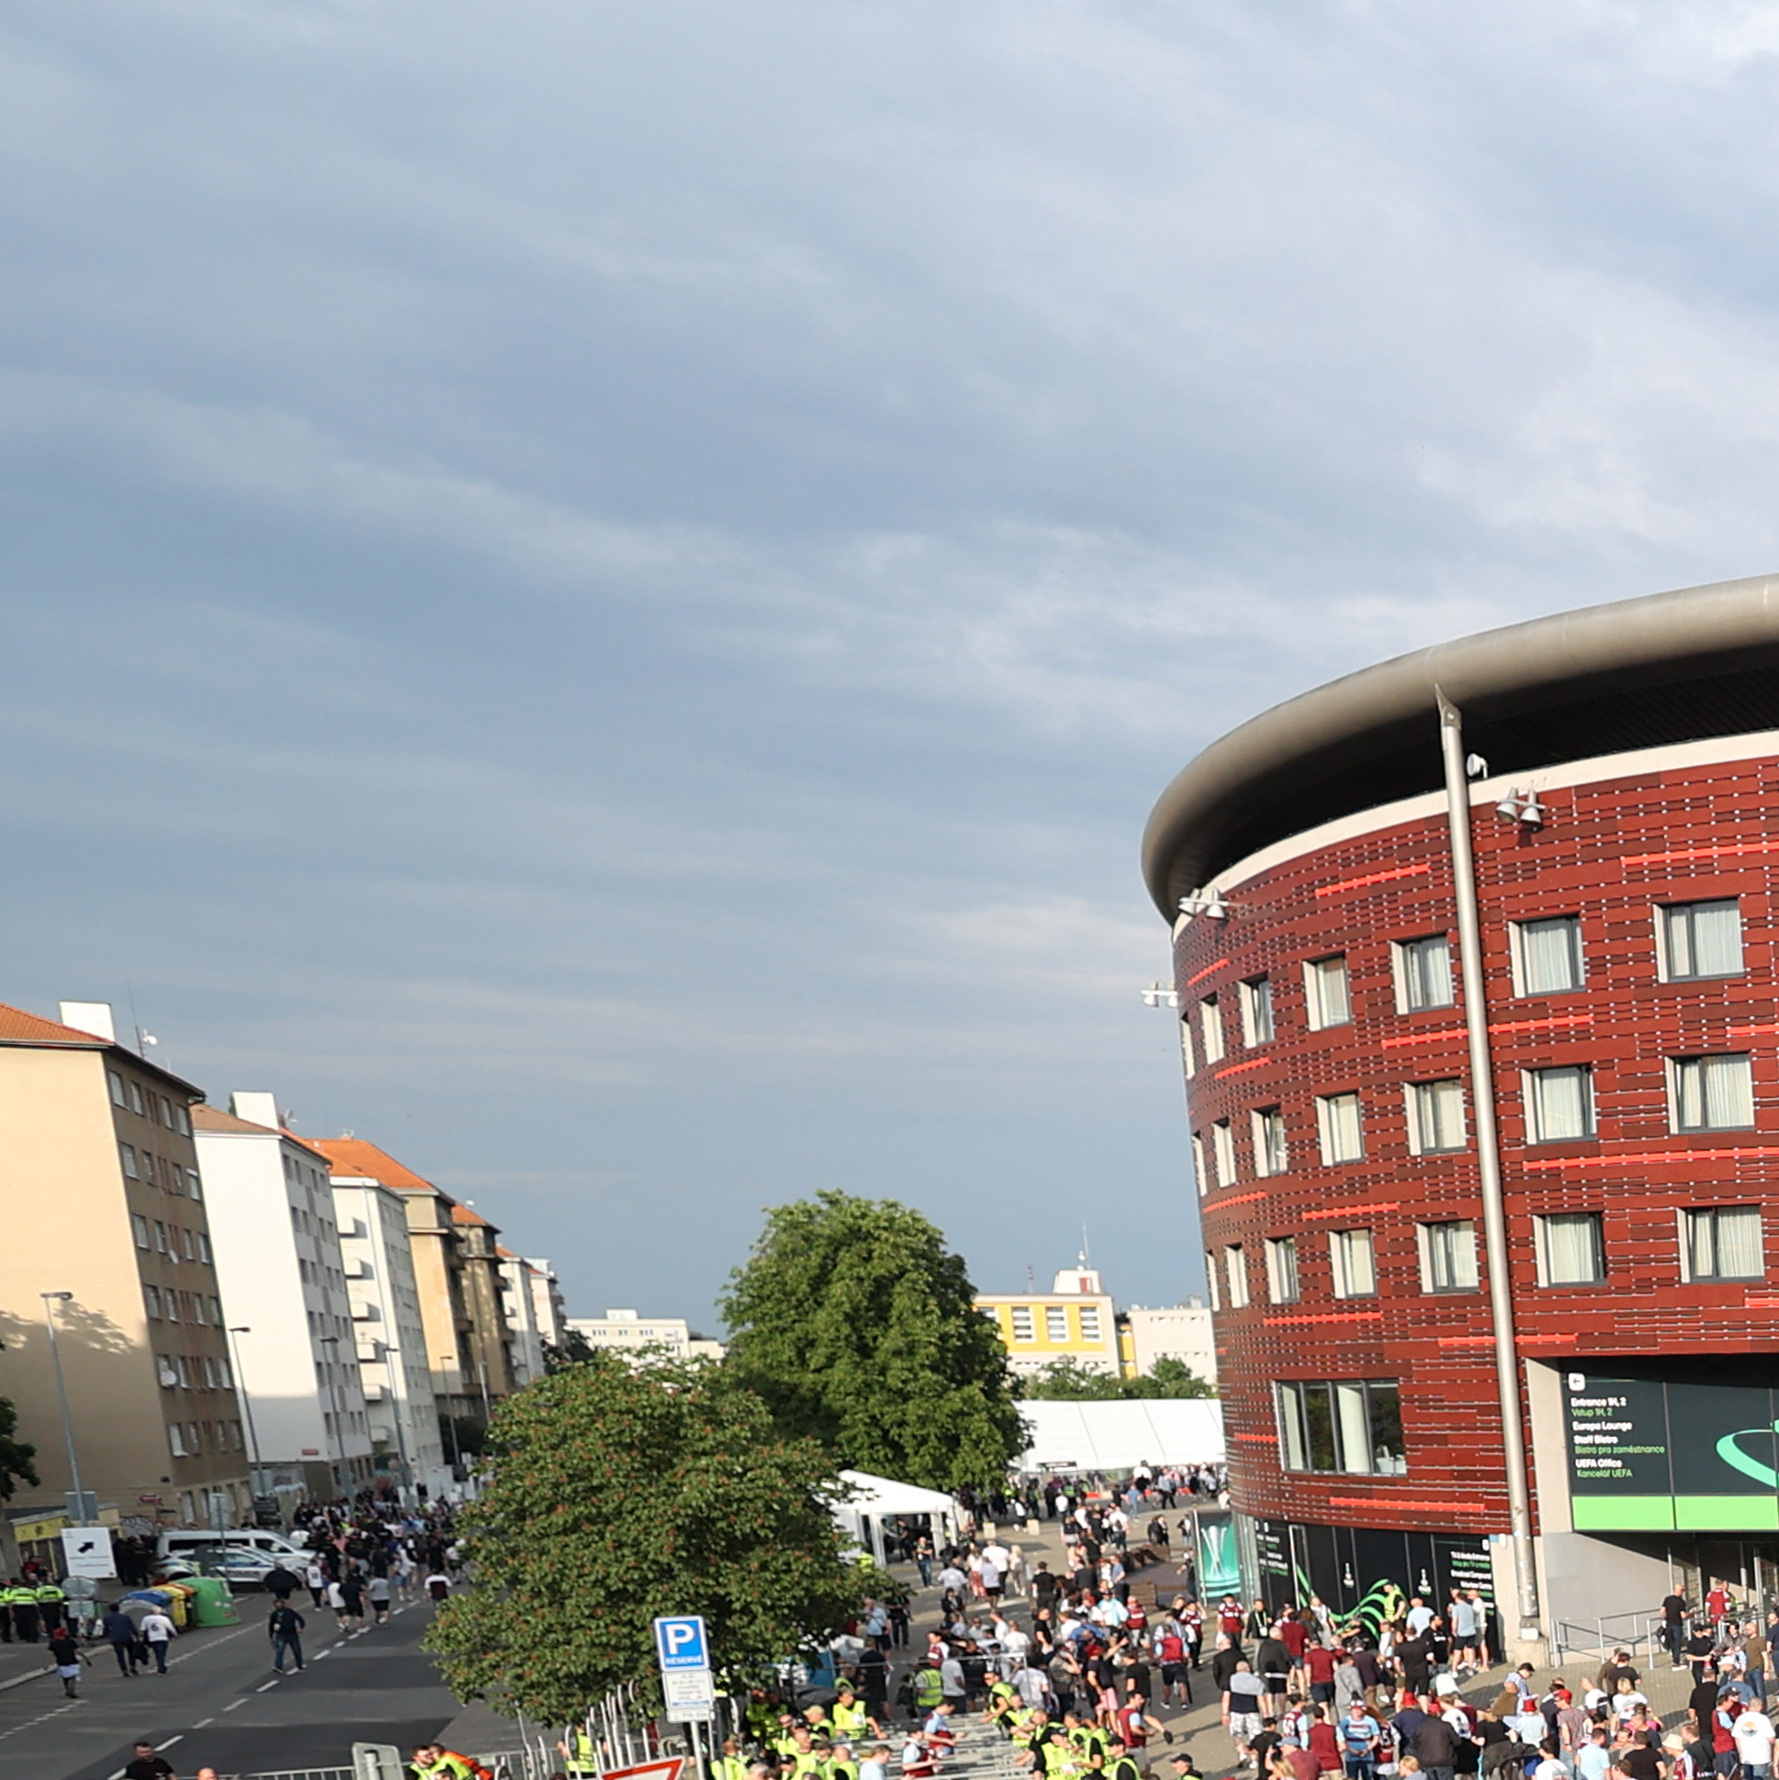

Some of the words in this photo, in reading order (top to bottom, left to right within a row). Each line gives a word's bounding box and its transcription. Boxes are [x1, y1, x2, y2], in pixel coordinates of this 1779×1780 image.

[1601, 1421, 1632, 1432] Lounge
[1575, 1459, 1597, 1468] UEFA
[1611, 1469, 1633, 1478] UEFA
[665, 1623, 695, 1655] P
